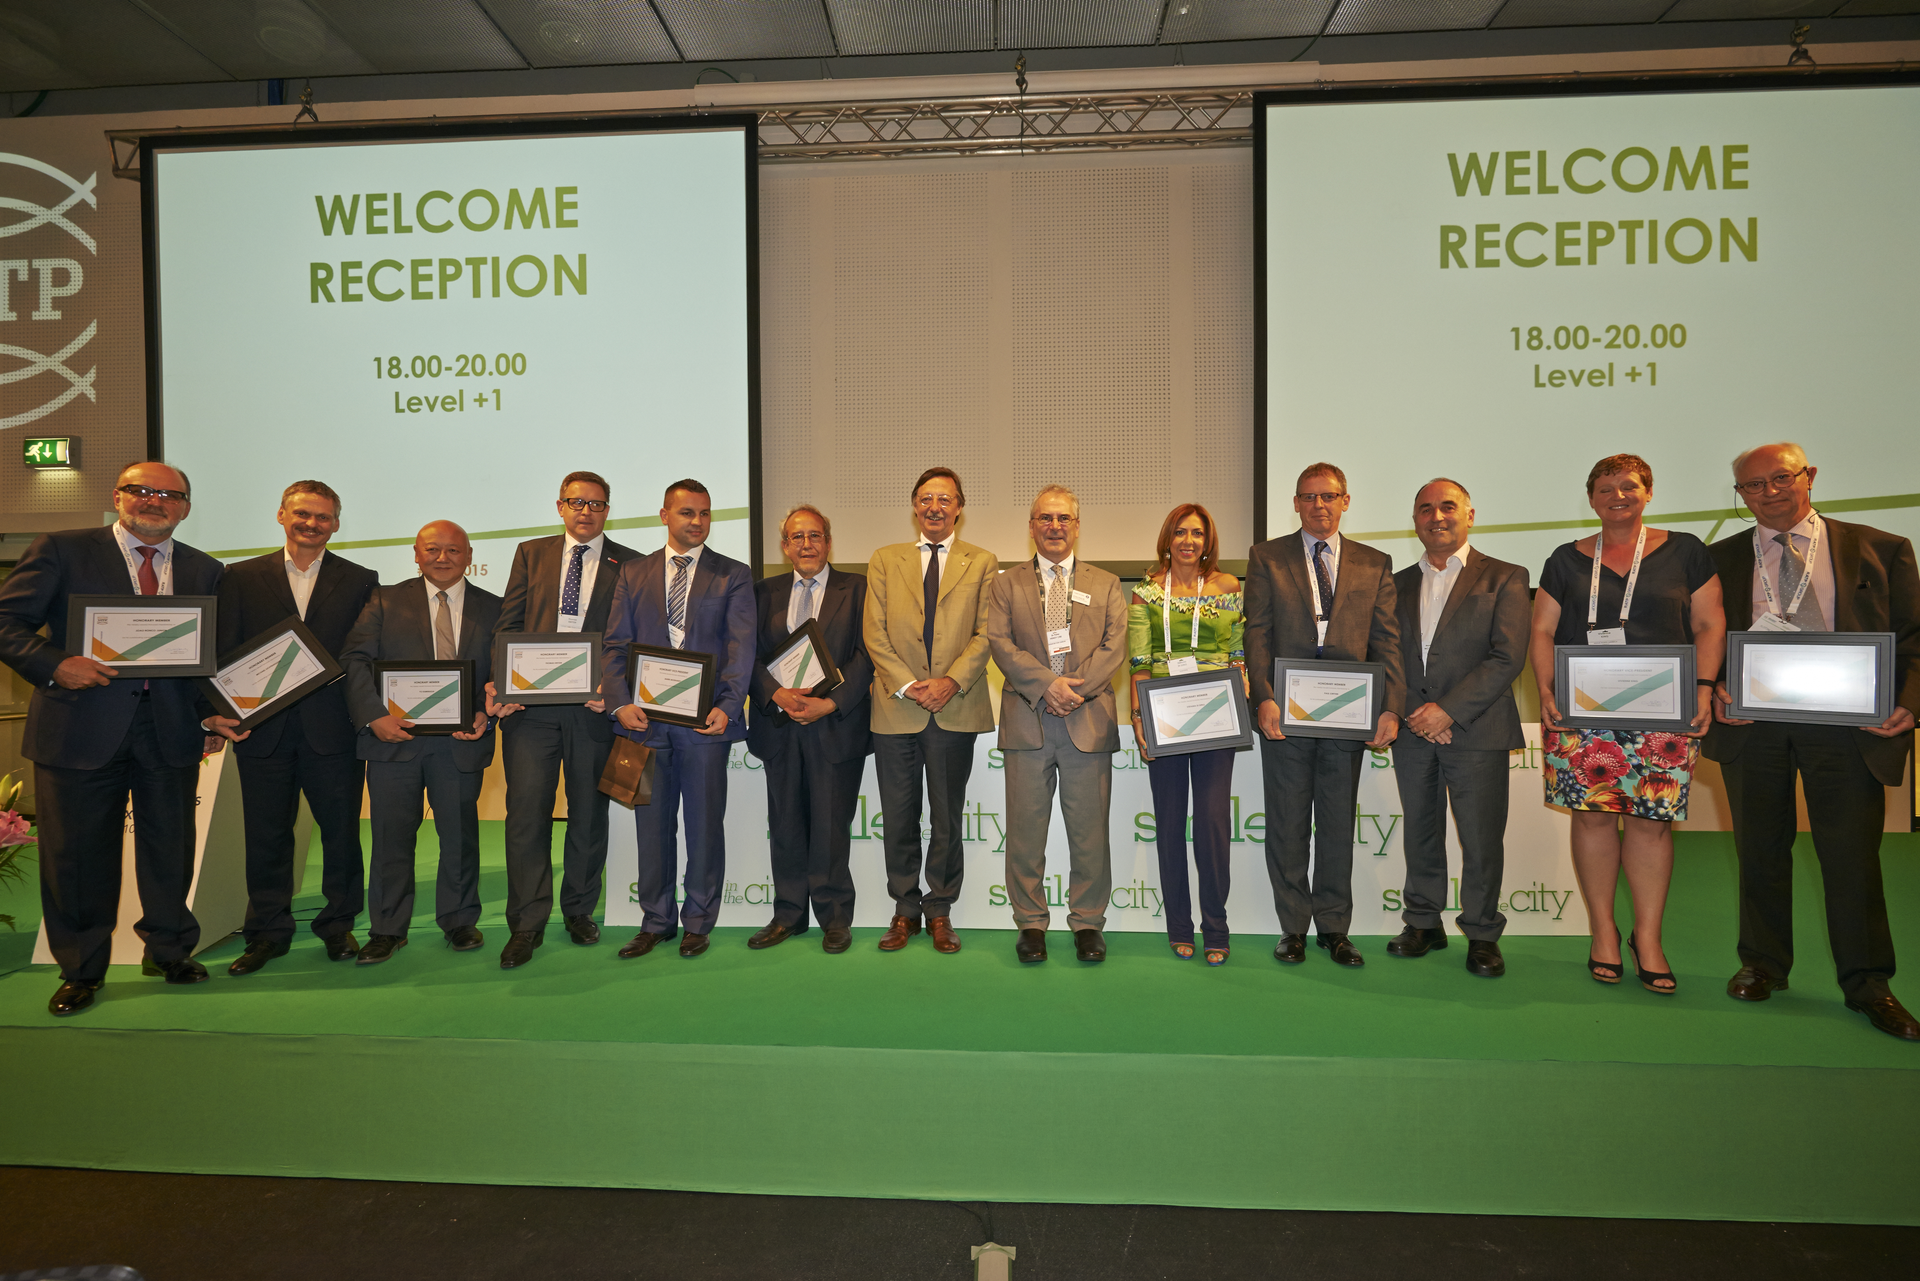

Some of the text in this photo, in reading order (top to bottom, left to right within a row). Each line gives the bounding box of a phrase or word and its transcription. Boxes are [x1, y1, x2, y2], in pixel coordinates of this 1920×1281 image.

[1447, 143, 1750, 197] WELCOME
[315, 186, 580, 237] WELCOME
[1439, 217, 1759, 269] RECEPTION
[310, 253, 588, 304] RECEPTION
[1510, 323, 1687, 351] 18.00-20.00
[373, 353, 528, 380] 18.00-20.00
[1534, 361, 1658, 389] Level +1
[394, 389, 502, 414] Level +1
[1509, 881, 1574, 920] city
